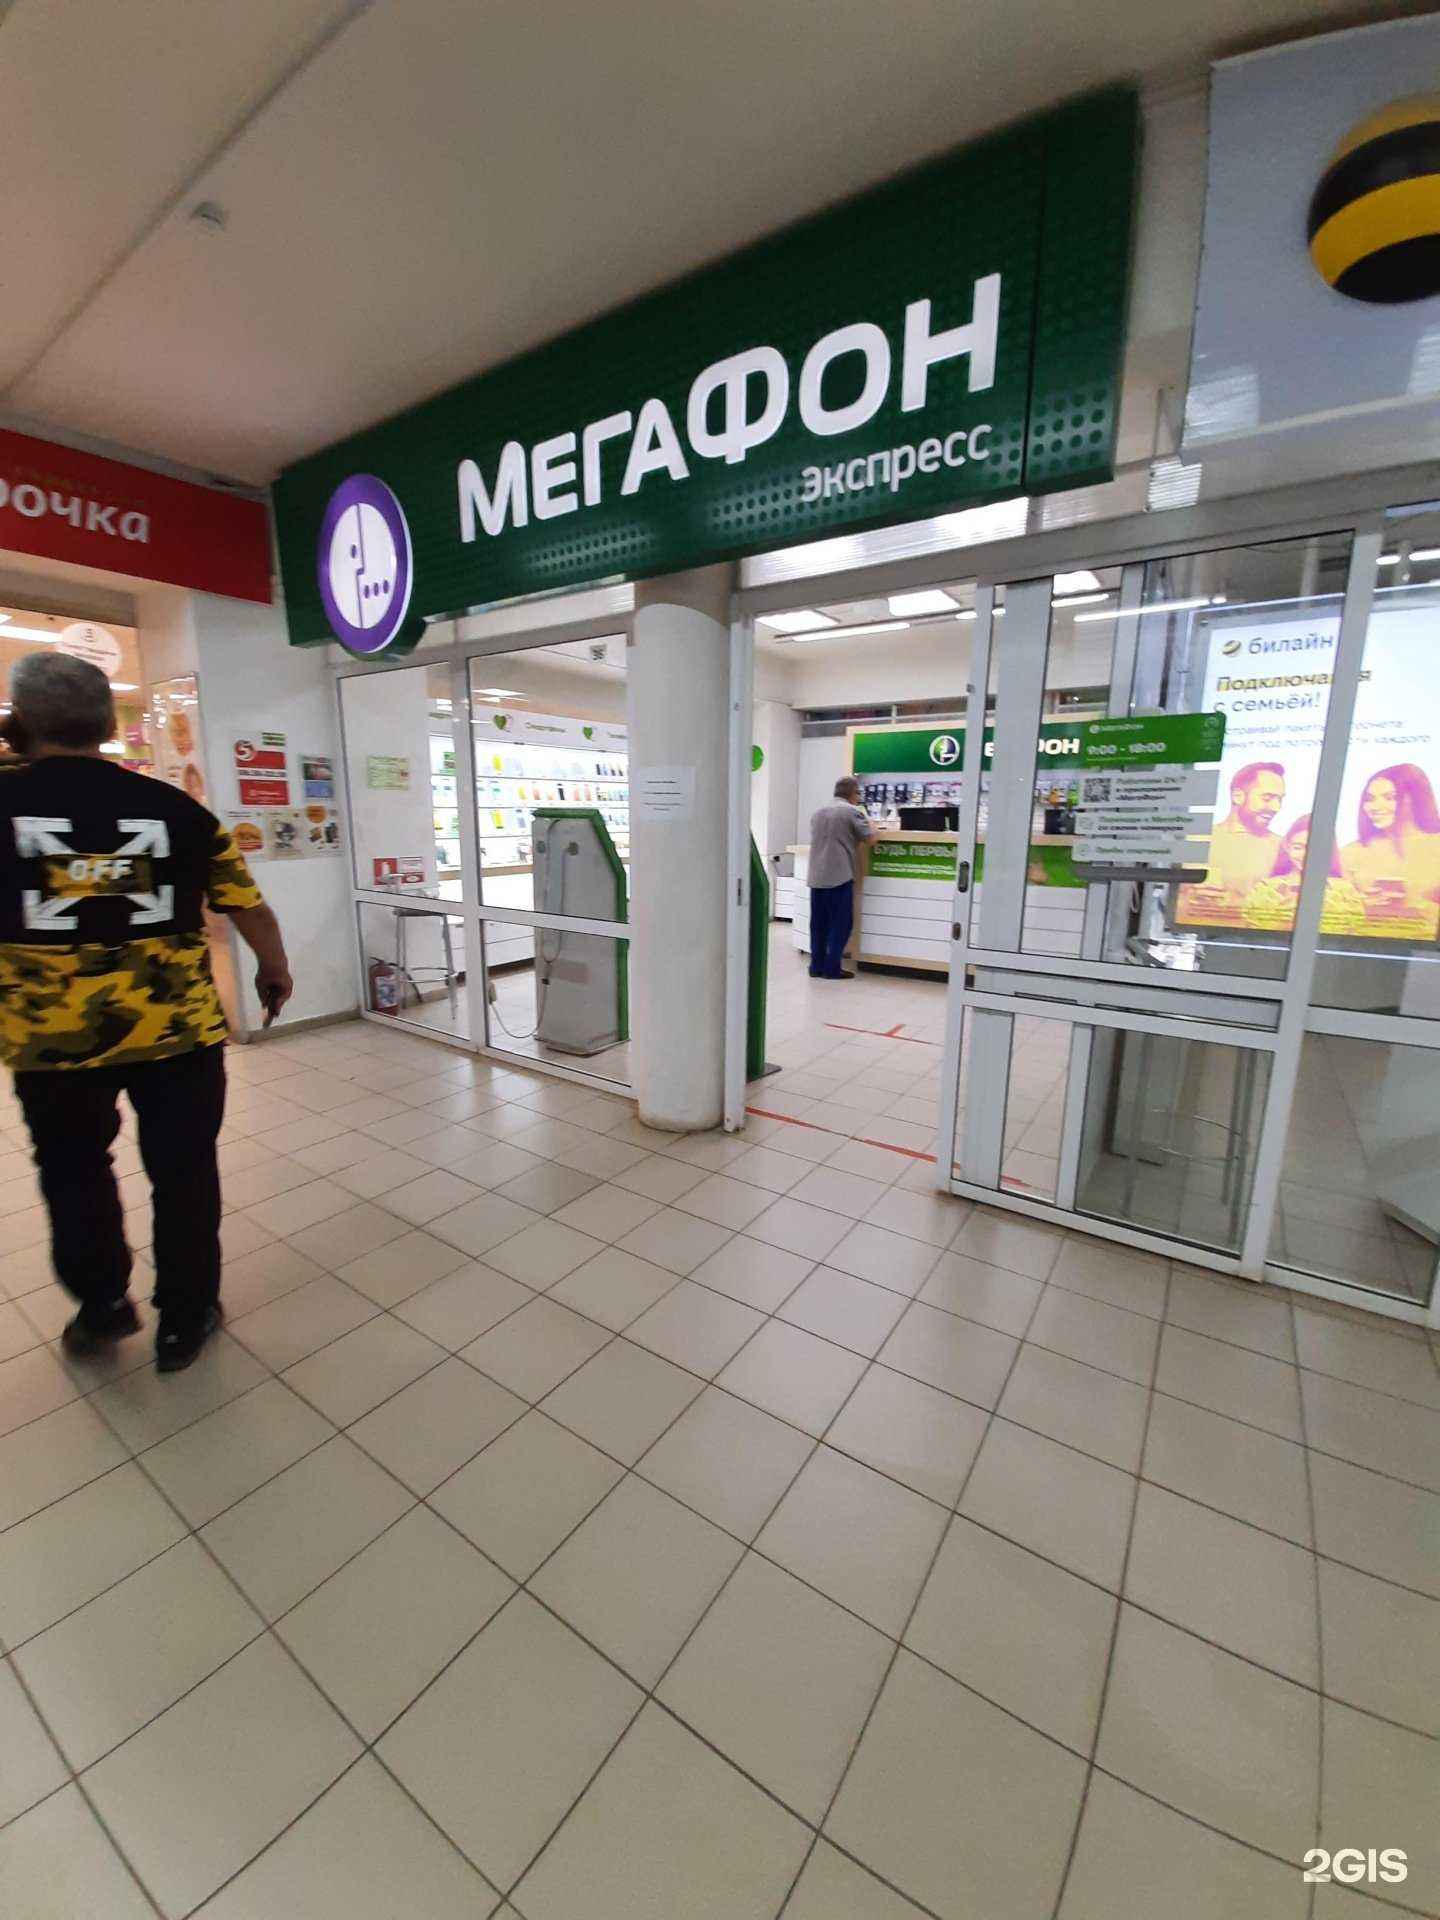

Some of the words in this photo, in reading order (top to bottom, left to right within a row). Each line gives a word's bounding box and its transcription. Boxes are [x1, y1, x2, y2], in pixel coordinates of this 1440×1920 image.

[457, 272, 1002, 543] МЕГАФОН
[799, 423, 993, 505] экспресс
[1248, 632, 1334, 654] билайн
[1216, 669, 1373, 693] Подключая
[1231, 691, 1321, 713] семьёй!
[908, 845, 958, 859] ПЕРВЫ
[66, 857, 135, 882] OFF
